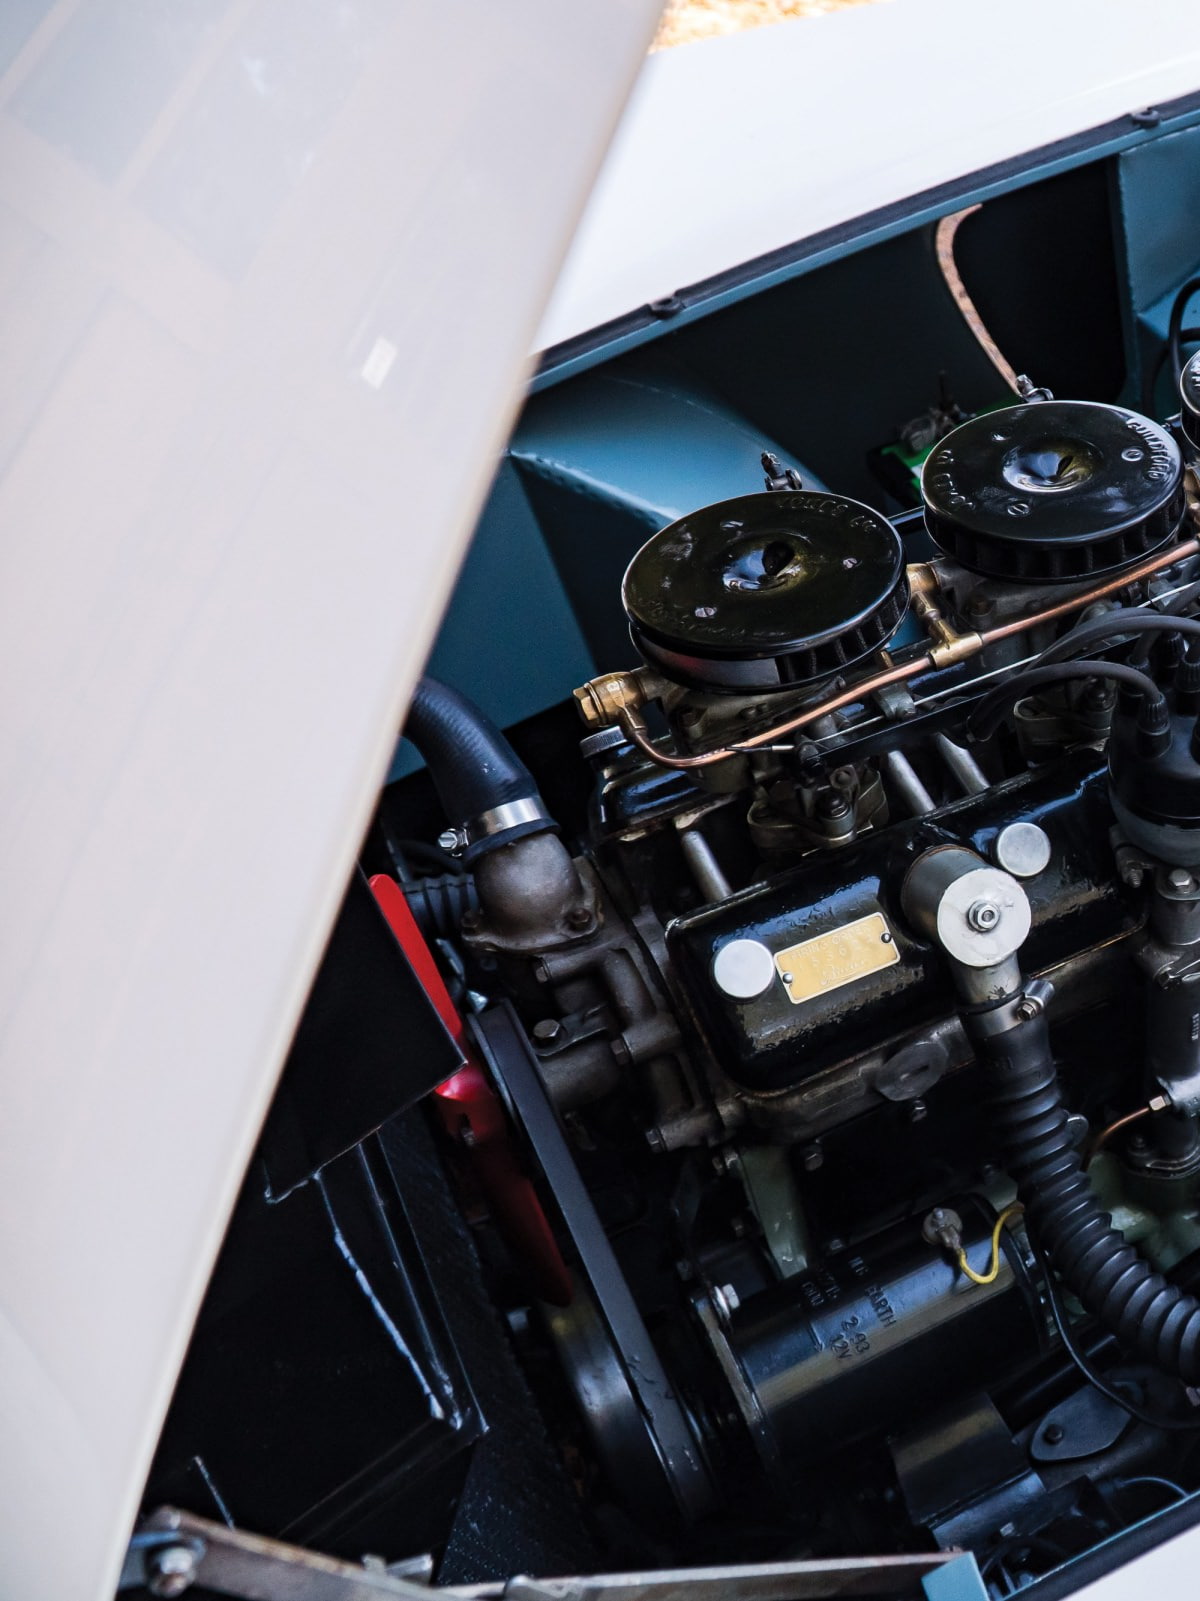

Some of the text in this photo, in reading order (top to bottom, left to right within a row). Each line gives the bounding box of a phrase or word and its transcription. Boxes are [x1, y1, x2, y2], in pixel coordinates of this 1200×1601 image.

[1125, 417, 1172, 481] GUILDFORD
[864, 1285, 897, 1328] EARTH
[829, 1332, 854, 1361] 12V
